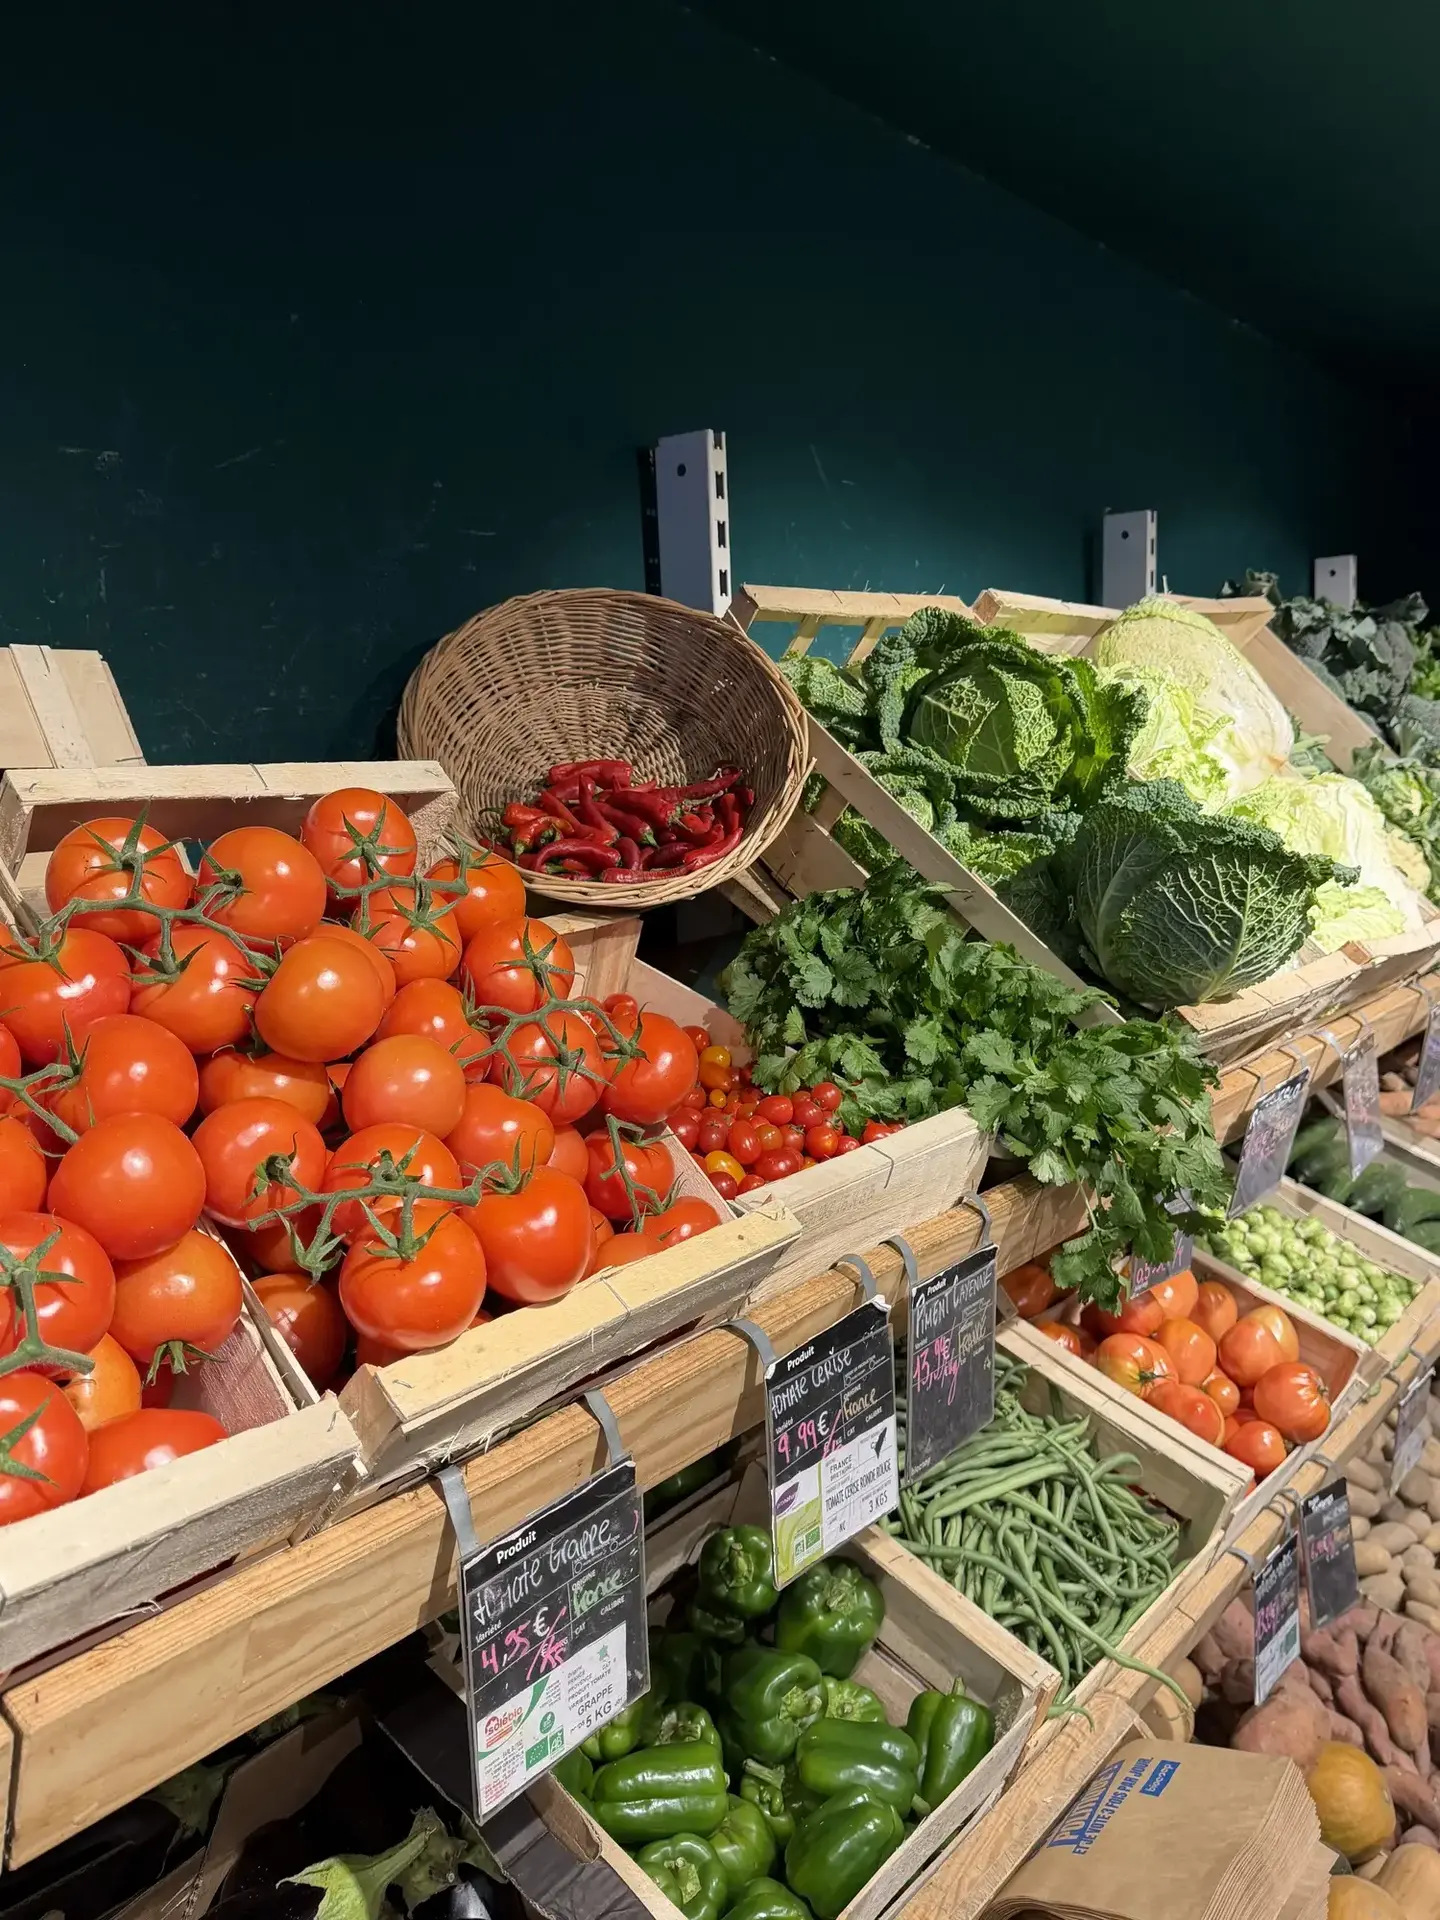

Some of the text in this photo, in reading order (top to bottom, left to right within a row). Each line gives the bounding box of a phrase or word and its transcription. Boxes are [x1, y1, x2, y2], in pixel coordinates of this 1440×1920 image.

[927, 1278, 946, 1296] Produit
[787, 1345, 815, 1371] Produit
[830, 1454, 852, 1473] FRANCE
[496, 1530, 537, 1564] Produit
[574, 1595, 625, 1635] CAT CALIBRE
[476, 1619, 501, 1643] Variété
[578, 1684, 613, 1715] GRAPPE
[586, 1714, 592, 1728] 5
[595, 1701, 612, 1720] KG
[1117, 1775, 1139, 1792] PAR
[1145, 1763, 1174, 1793] biocoop
[1105, 1791, 1128, 1809] FOIS
[1087, 1811, 1111, 1835] VOTE
[1072, 1842, 1090, 1855] ET
[1081, 1831, 1097, 1846] JE
